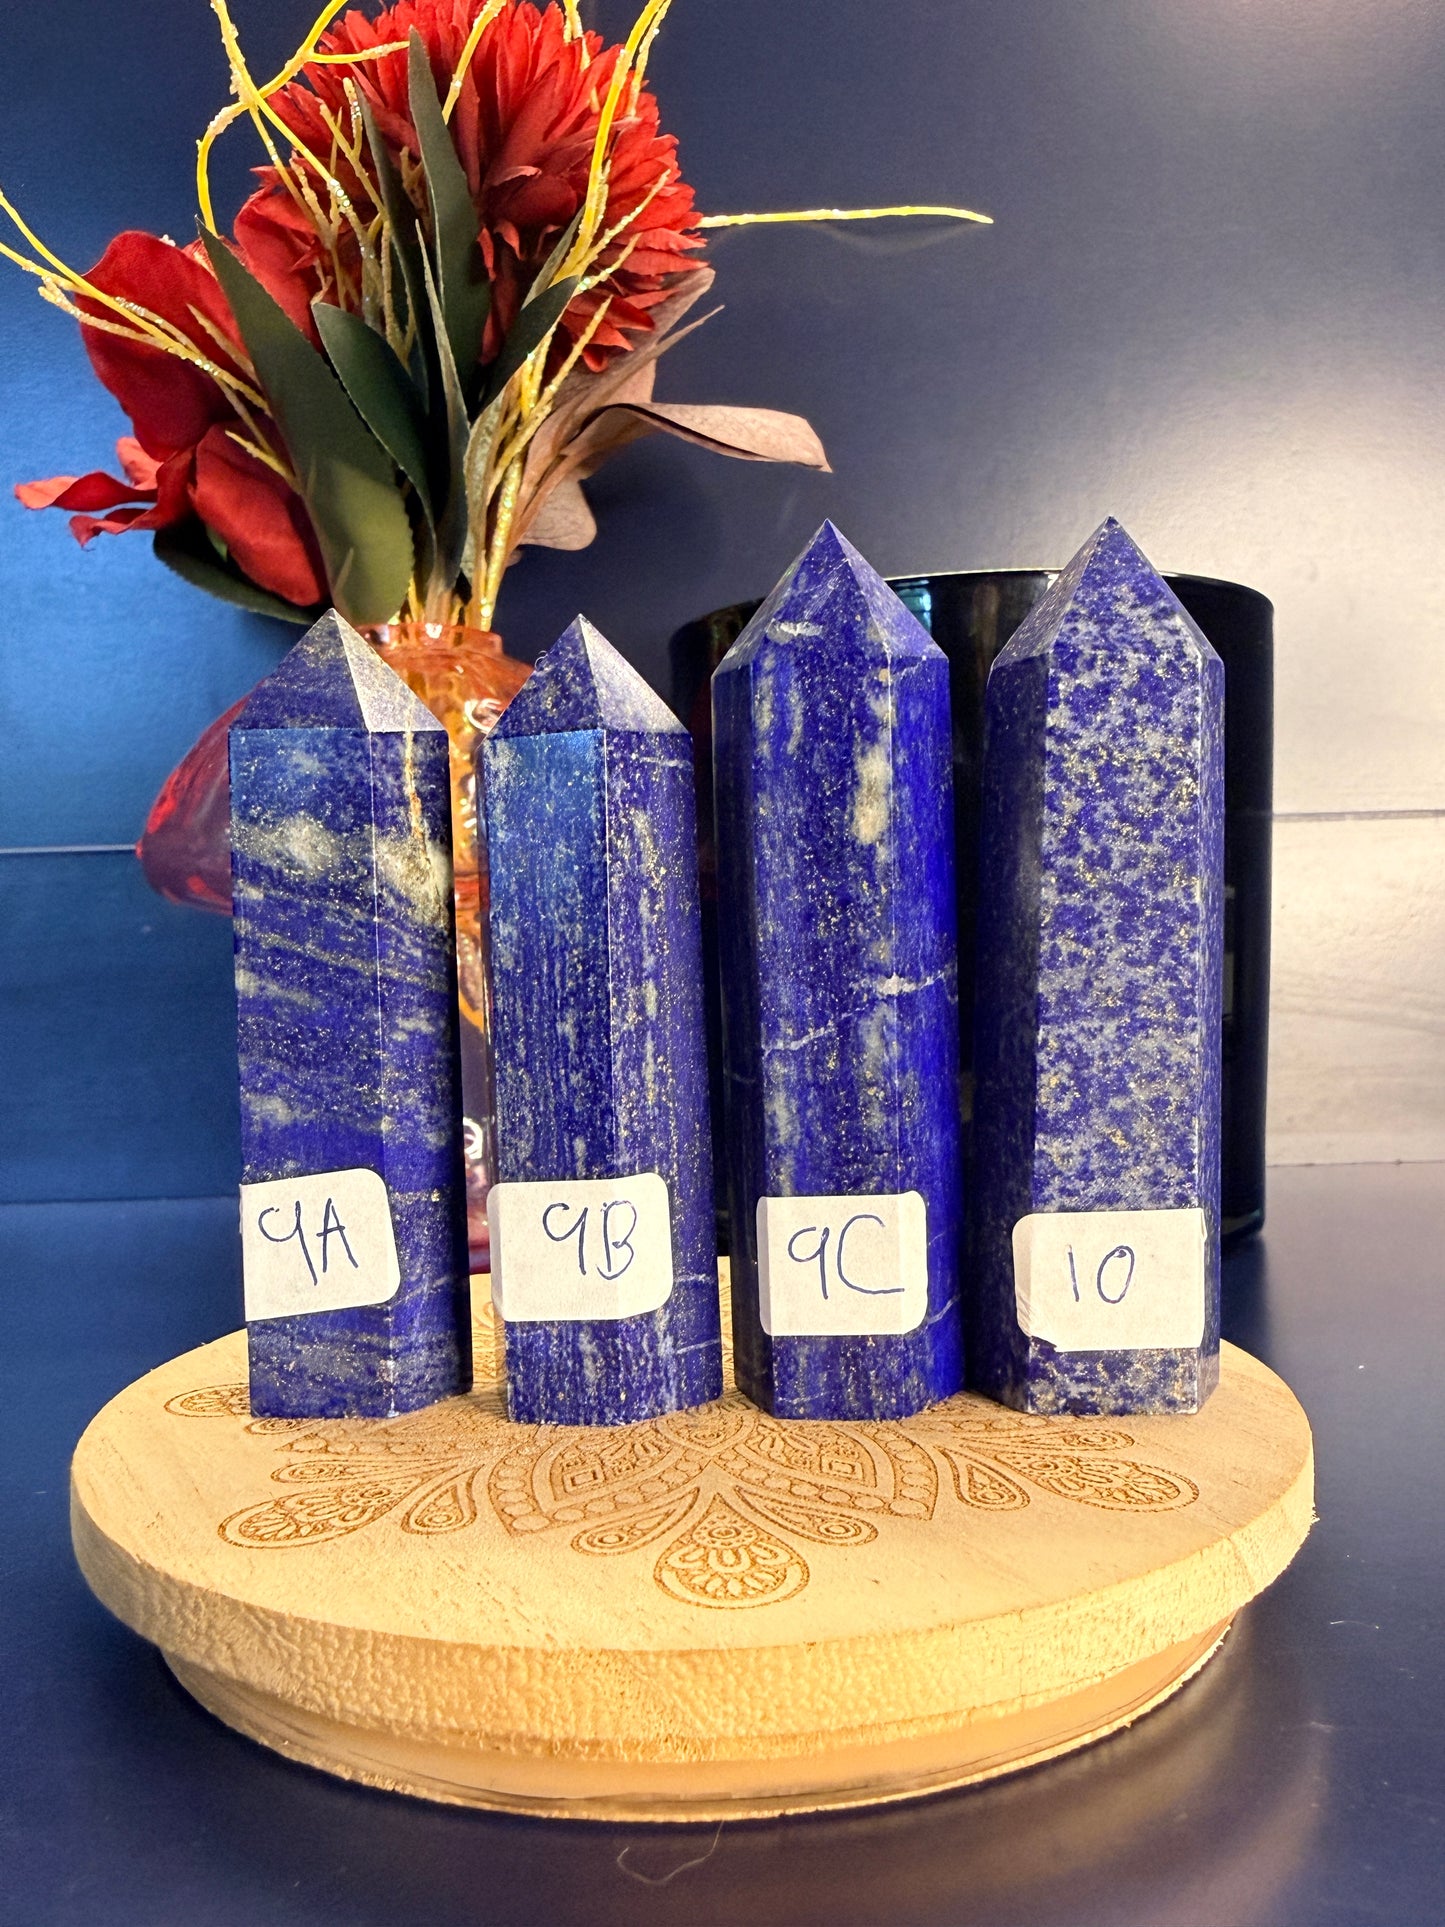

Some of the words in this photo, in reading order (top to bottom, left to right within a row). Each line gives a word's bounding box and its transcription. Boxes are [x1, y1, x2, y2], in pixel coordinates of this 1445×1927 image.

[258, 1197, 359, 1286] 9A
[542, 1200, 638, 1281] 9B
[787, 1213, 905, 1300] 9C
[1065, 1244, 1136, 1304] 10
